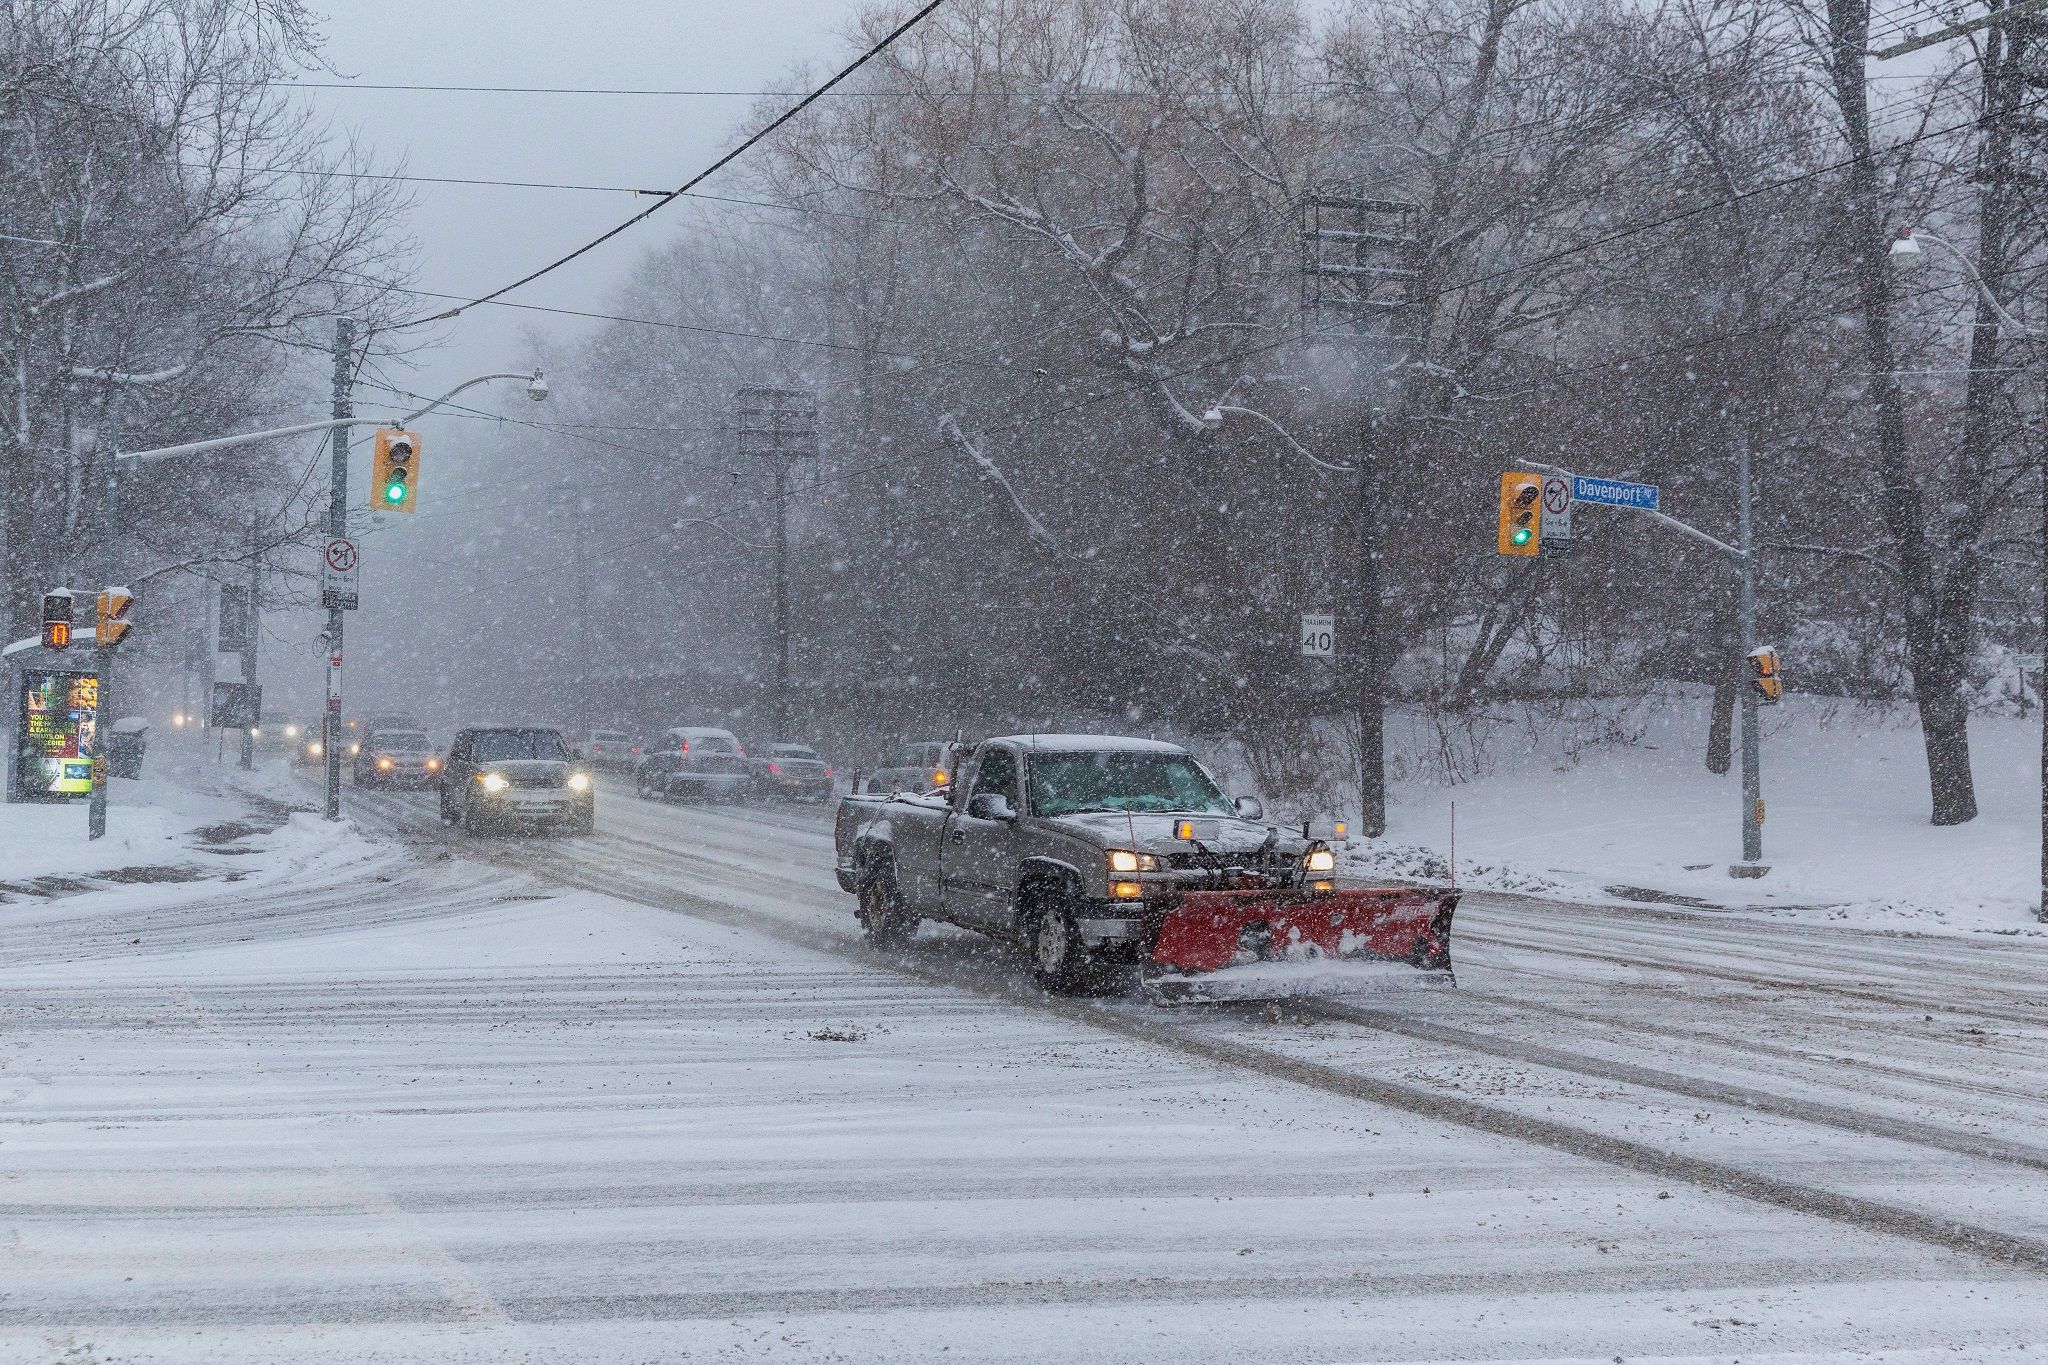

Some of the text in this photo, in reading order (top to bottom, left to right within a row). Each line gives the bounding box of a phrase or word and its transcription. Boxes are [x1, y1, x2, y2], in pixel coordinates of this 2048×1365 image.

[1579, 479, 1641, 503] Davenport
[1304, 618, 1332, 626] MAXIMUM
[1304, 632, 1332, 651] 40
